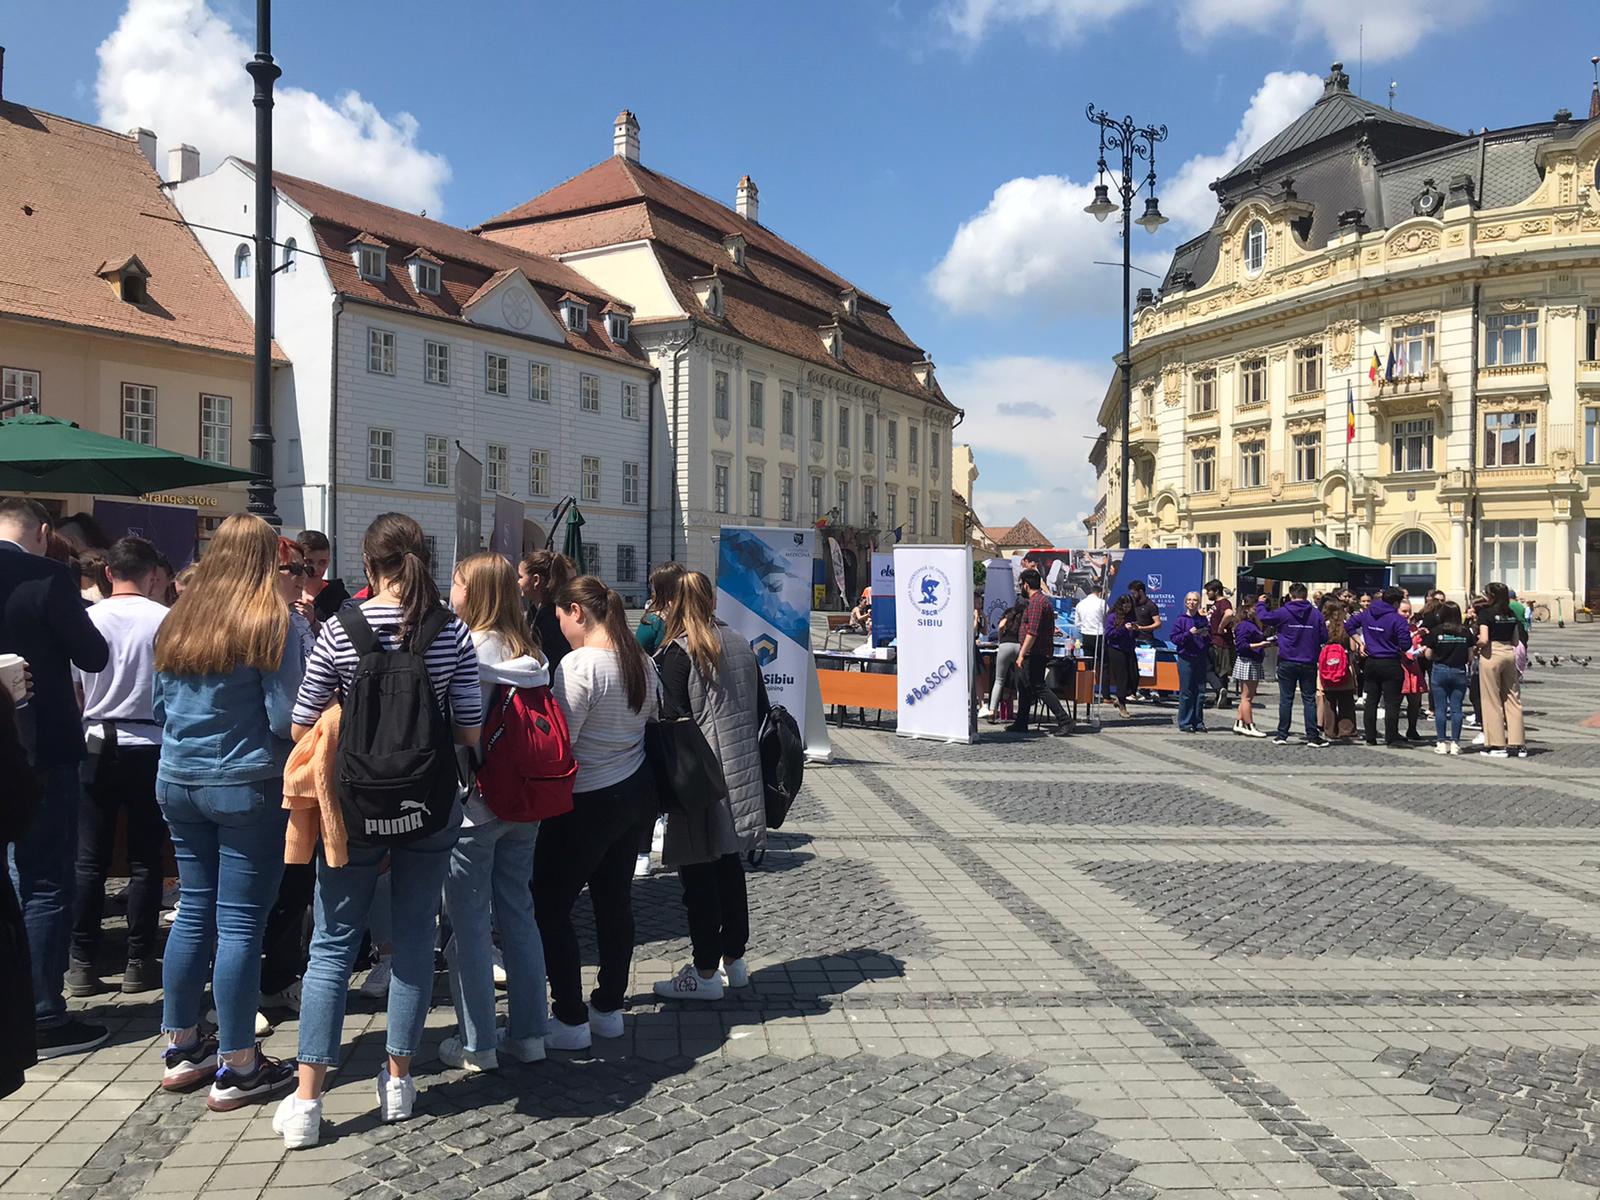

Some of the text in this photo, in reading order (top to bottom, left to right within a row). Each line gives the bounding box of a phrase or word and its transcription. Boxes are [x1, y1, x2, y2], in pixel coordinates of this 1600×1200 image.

[188, 494, 218, 506] store
[917, 618, 943, 627] SIBIU
[763, 673, 794, 685] Sibiu
[905, 659, 957, 706] #BeSSCR
[365, 810, 424, 835] PUMA
